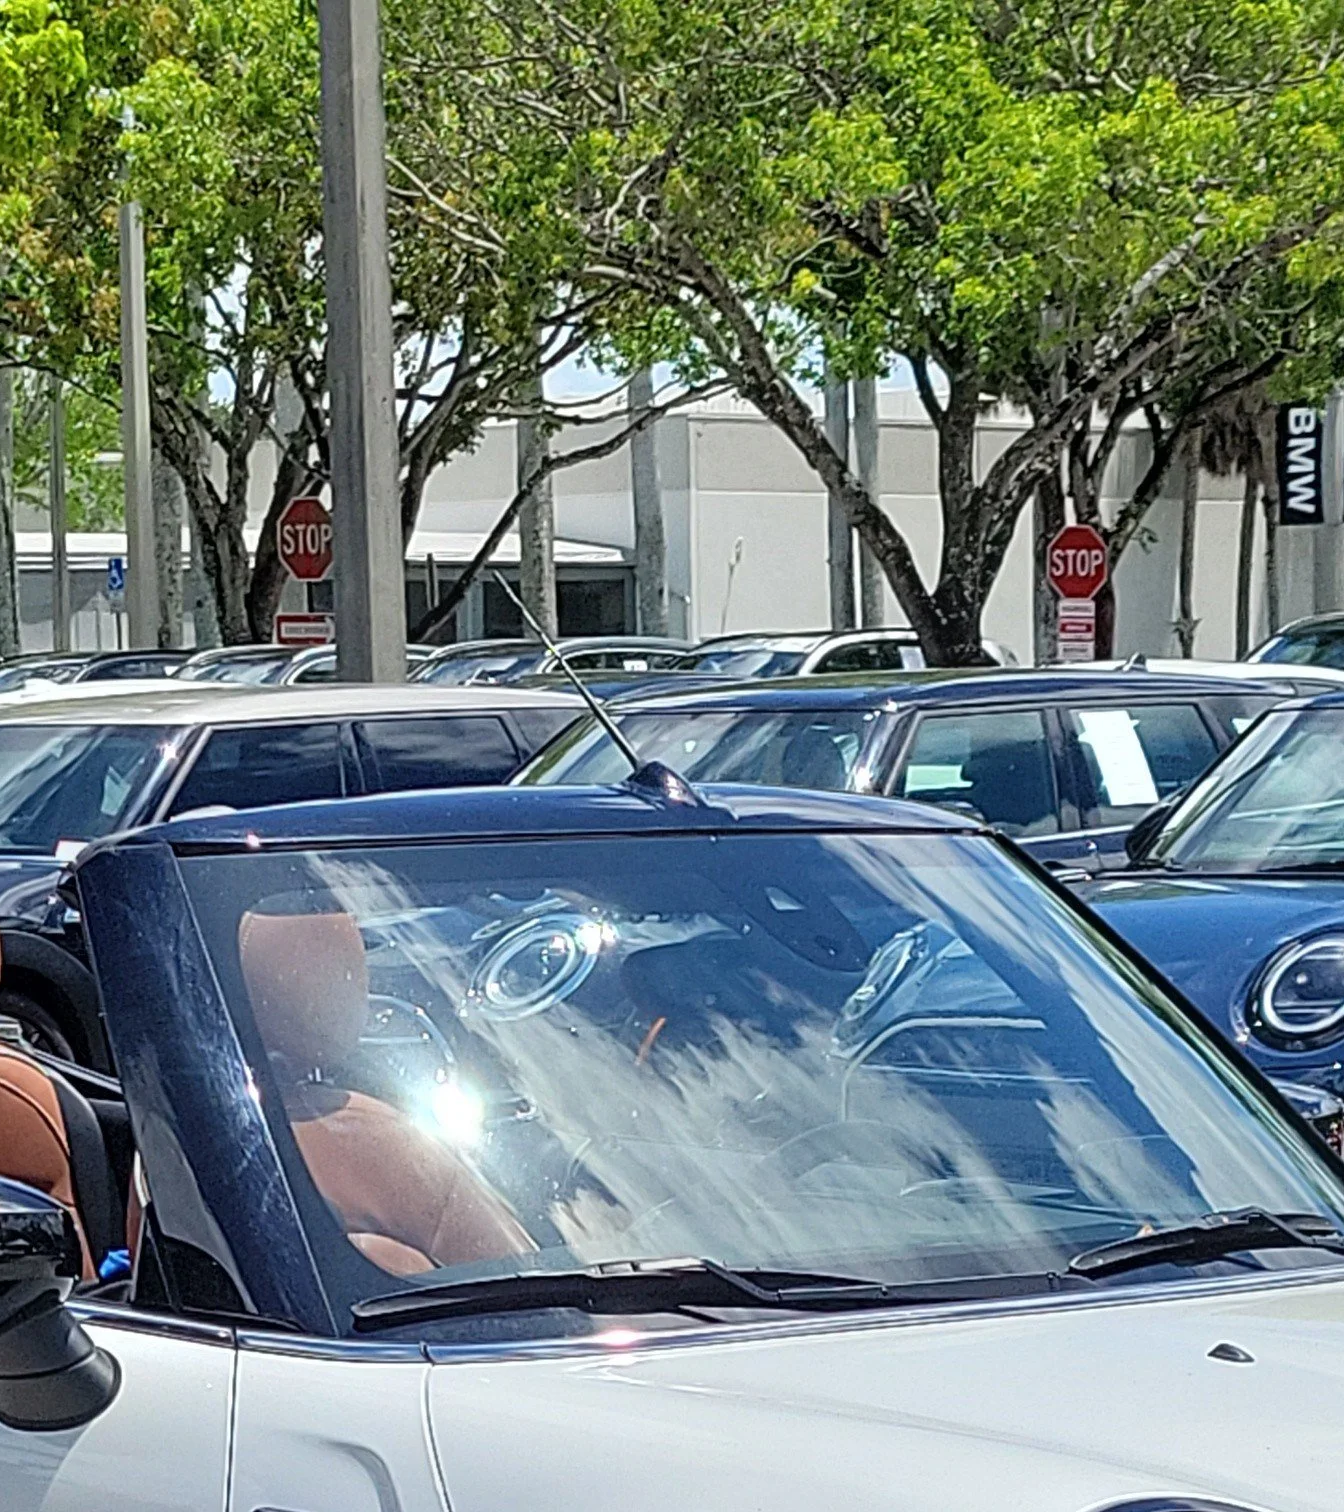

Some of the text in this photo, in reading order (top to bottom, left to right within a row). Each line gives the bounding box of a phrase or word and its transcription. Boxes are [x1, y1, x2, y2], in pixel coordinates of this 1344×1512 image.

[1286, 407, 1316, 514] BMW
[282, 523, 333, 555] STOP
[1051, 548, 1104, 577] STOP
